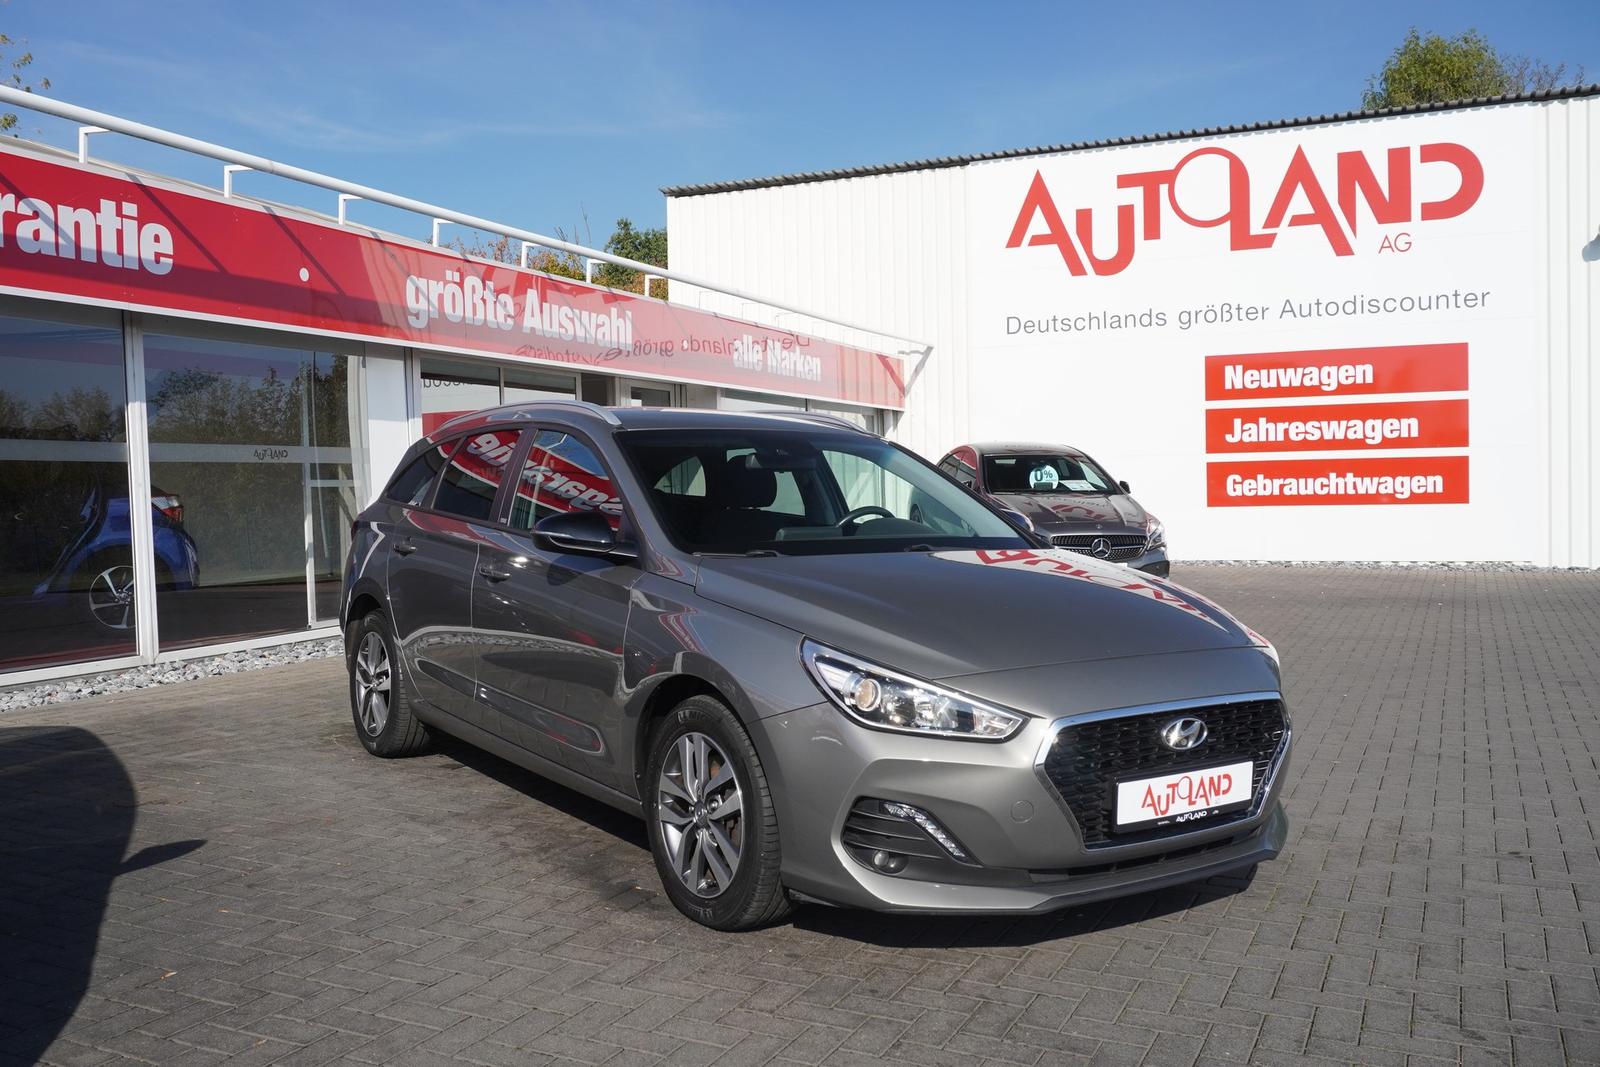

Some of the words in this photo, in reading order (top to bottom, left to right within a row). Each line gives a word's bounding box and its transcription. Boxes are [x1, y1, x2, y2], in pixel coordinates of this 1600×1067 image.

[1005, 142, 1485, 277] AUTOLAND
[1378, 232, 1413, 254] AG
[406, 270, 515, 331] größte
[522, 288, 633, 351] Auswahl
[1006, 306, 1167, 335] Deutschlands
[1178, 302, 1270, 331] größter
[1279, 288, 1491, 320] Autodiscounter
[733, 334, 763, 372] alle
[767, 338, 822, 382] Marken
[1224, 362, 1374, 391] Neuwagen
[1225, 416, 1419, 445] Jahreswagen
[1226, 472, 1444, 500] Gebrauchtwagen
[1141, 773, 1233, 817] AUTOLAND
